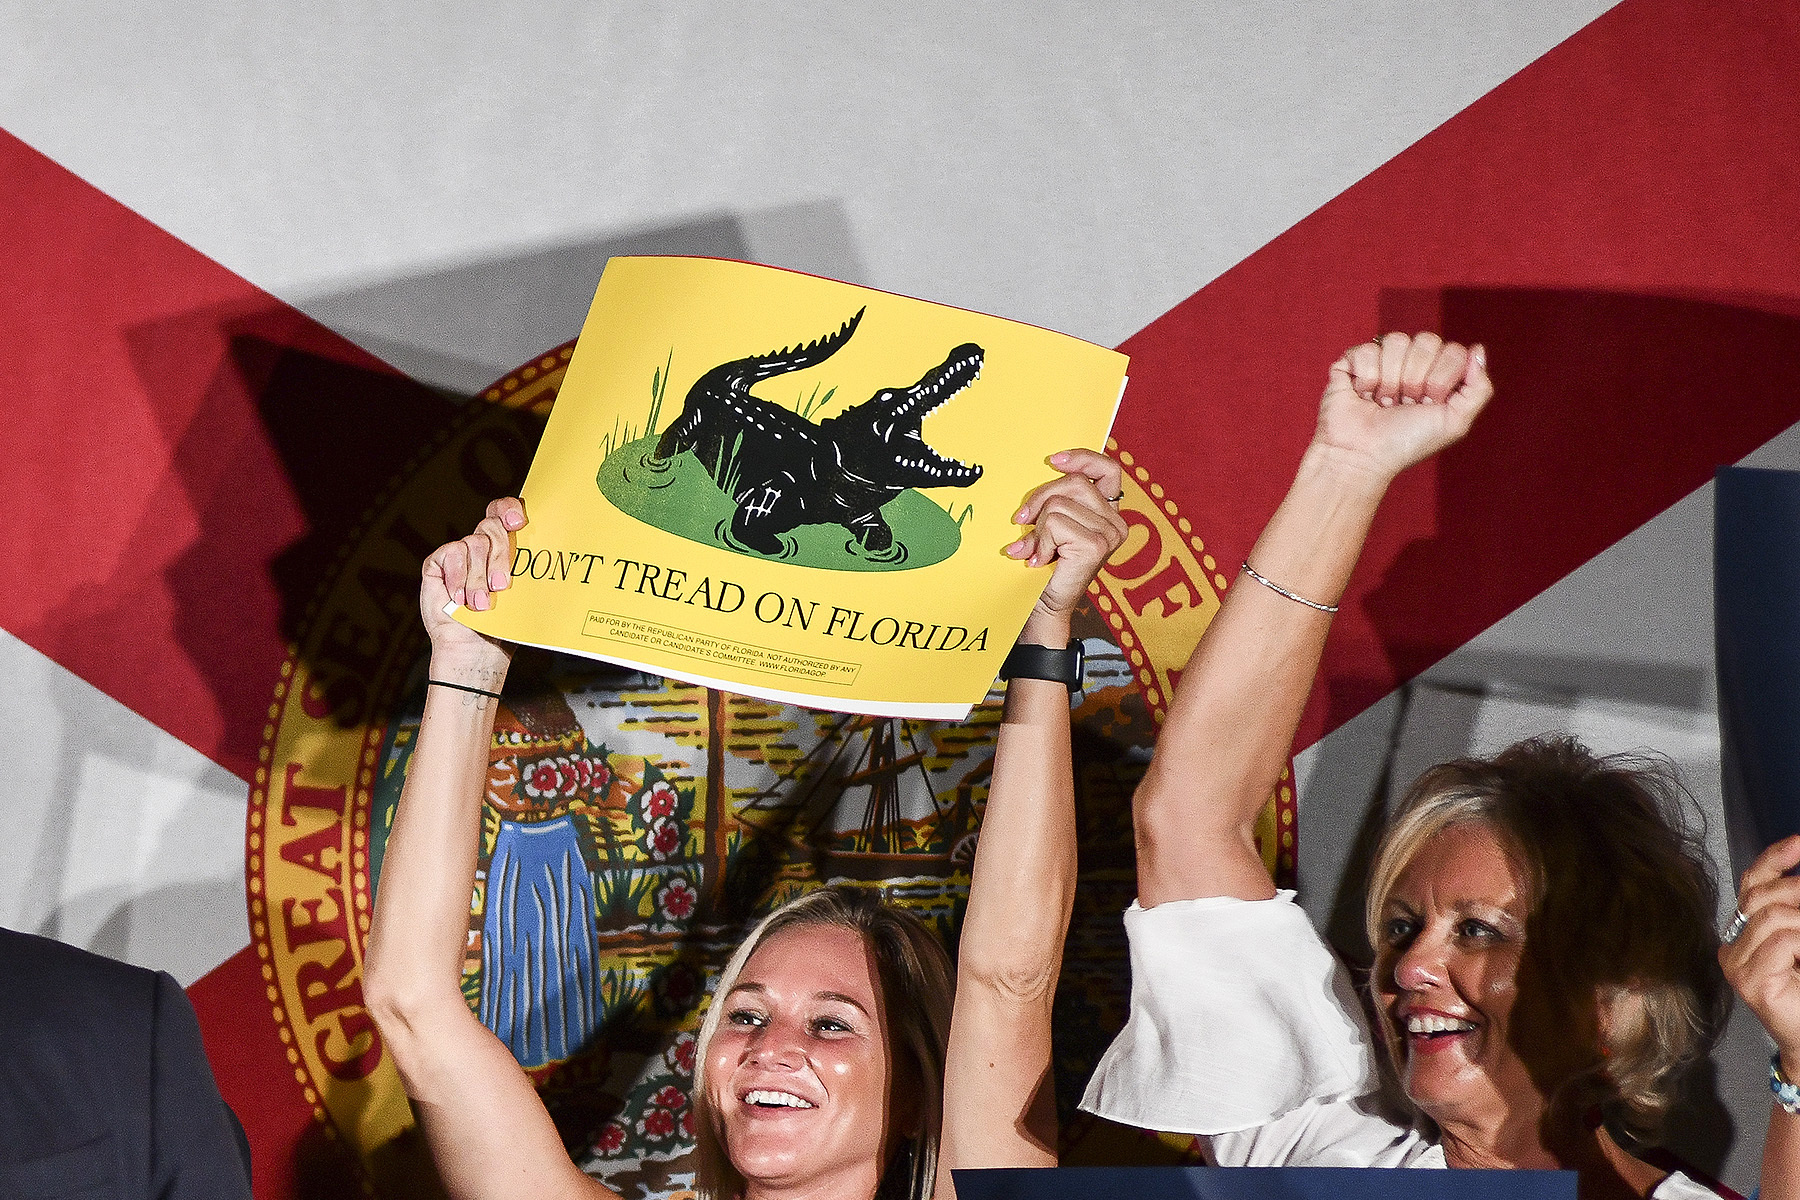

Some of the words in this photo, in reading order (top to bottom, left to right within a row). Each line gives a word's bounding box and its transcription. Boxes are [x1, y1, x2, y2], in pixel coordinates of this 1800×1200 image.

[510, 547, 604, 584] DON'T
[613, 558, 746, 613] TREAD
[754, 592, 820, 631] ON
[822, 606, 989, 651] FLORIDA
[589, 615, 605, 624] PAID
[605, 617, 620, 627] FOR
[621, 620, 631, 628] BY
[632, 623, 646, 632] THE
[647, 626, 695, 643] REPUBLICAN
[695, 637, 720, 648] PARTY
[720, 643, 731, 651] OF
[767, 653, 783, 661] NOT
[783, 656, 829, 670] AUTHORIZED
[609, 628, 650, 642] CANDIDATE
[650, 636, 662, 645] OR
[663, 639, 711, 656] CANDIDATE'S
[280, 763, 382, 1081] GREAT
[1103, 508, 1203, 618] OF
